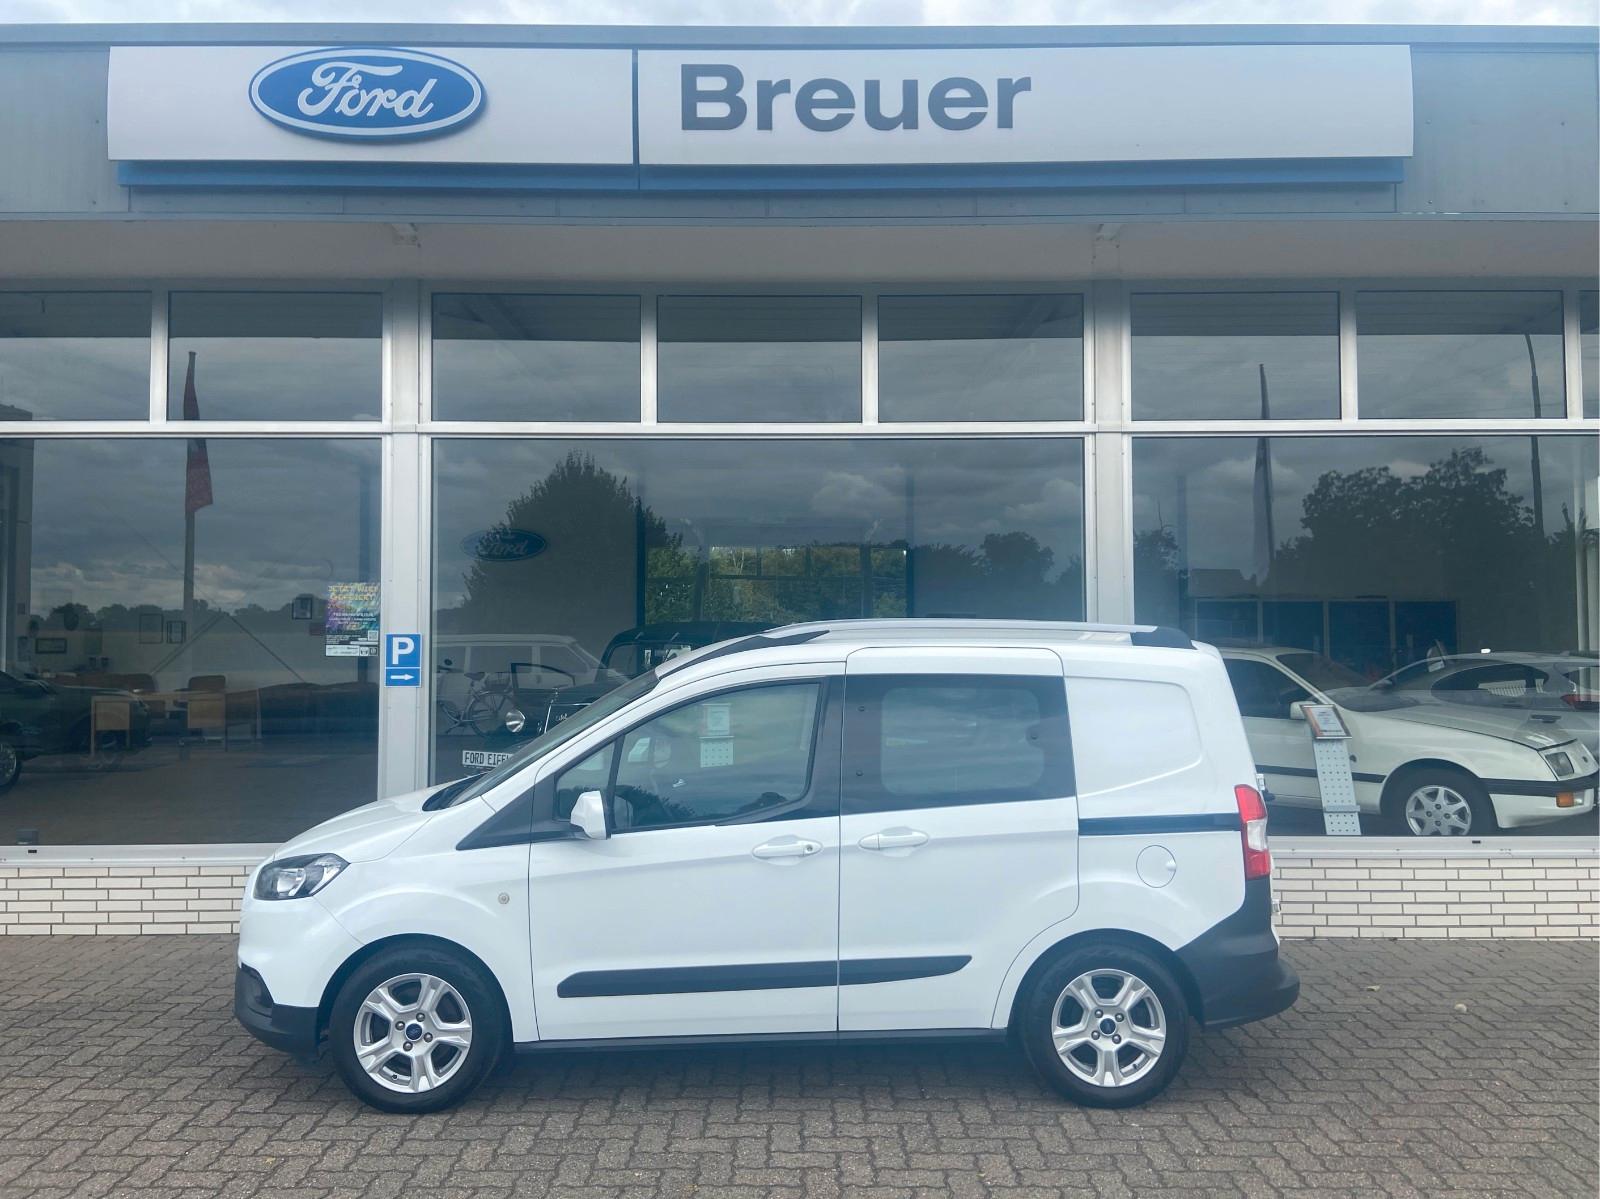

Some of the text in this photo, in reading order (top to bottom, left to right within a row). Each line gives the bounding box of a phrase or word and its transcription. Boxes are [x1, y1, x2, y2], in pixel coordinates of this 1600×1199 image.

[297, 61, 438, 118] Ford
[680, 63, 1032, 132] Breuer
[392, 637, 415, 665] P
[464, 752, 485, 765] FORD
